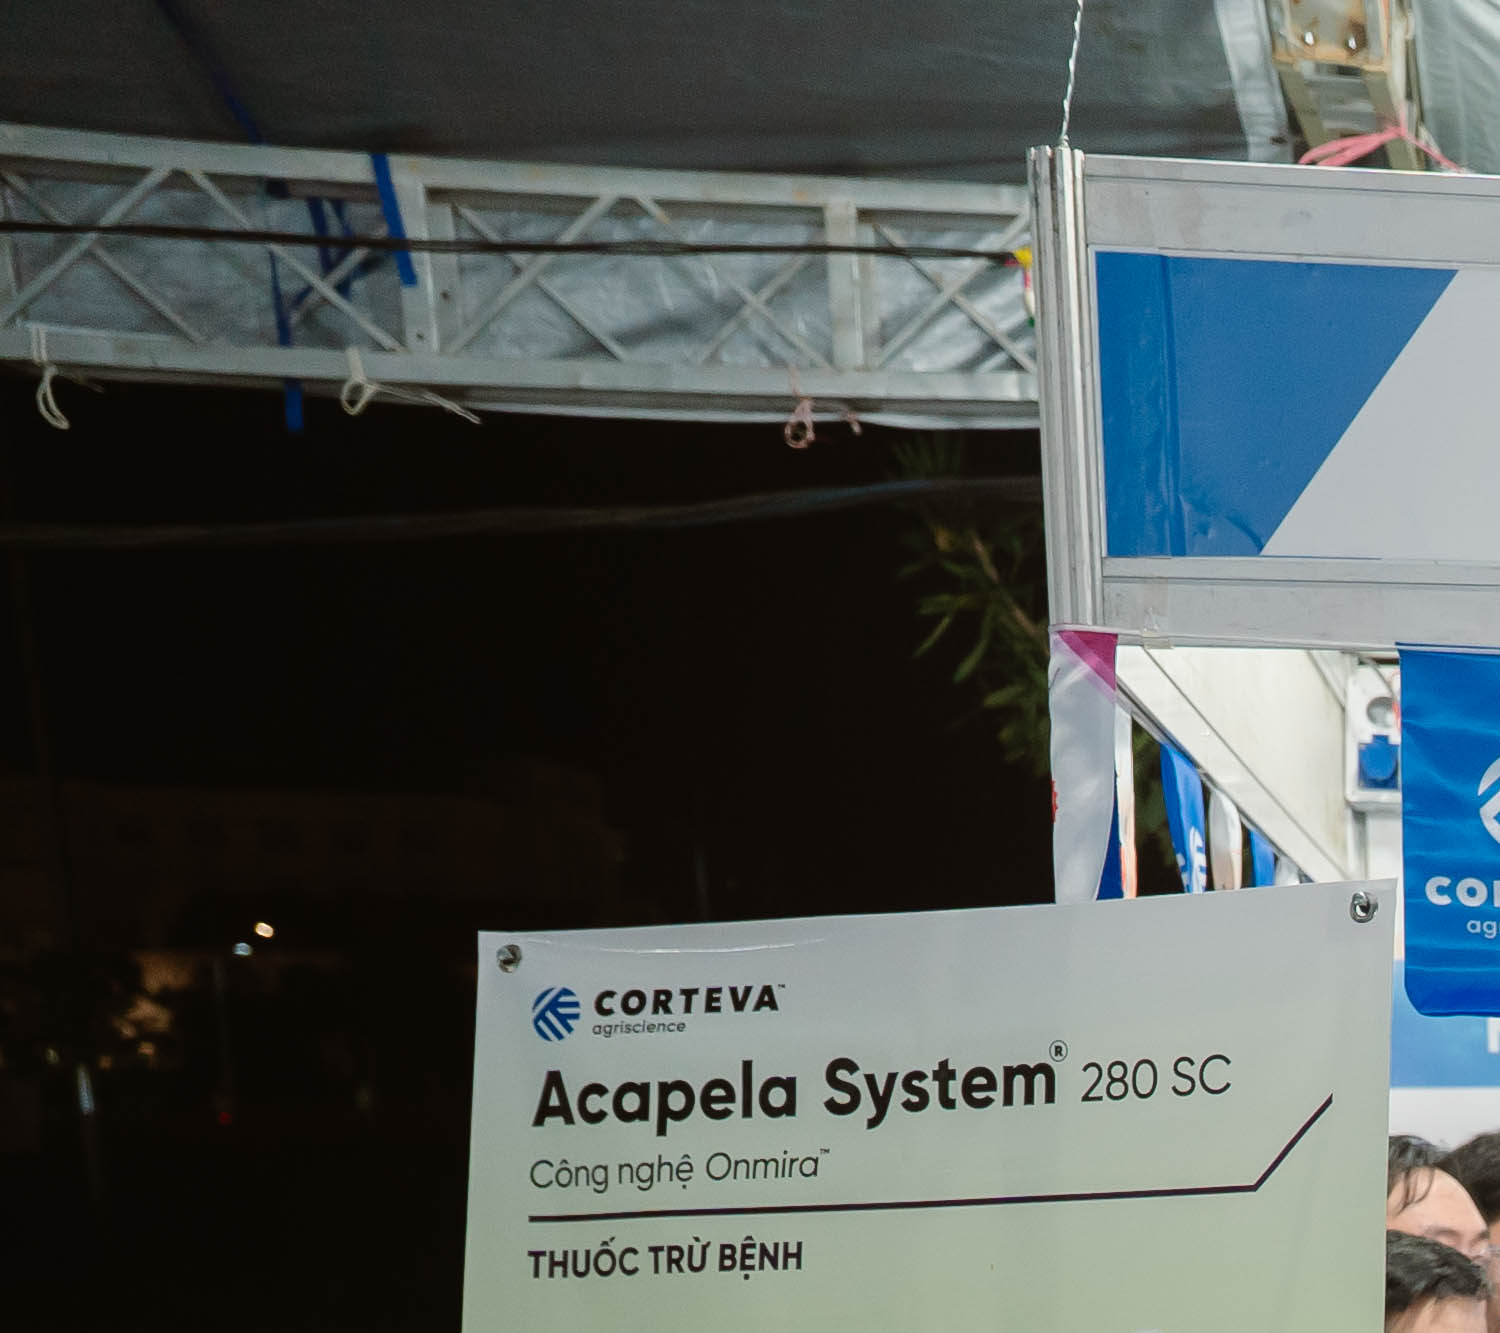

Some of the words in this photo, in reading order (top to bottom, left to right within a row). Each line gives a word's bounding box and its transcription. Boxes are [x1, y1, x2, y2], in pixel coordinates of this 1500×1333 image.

[592, 1018, 686, 1039] agriscience
[533, 1059, 798, 1137] Acapela
[1081, 1058, 1159, 1103] 280
[1171, 1054, 1233, 1098] SC
[530, 1155, 611, 1195] Công
[617, 1150, 696, 1191] nghệ
[527, 1237, 640, 1280] THUỐC
[648, 1237, 715, 1277] TRỪ
[717, 1239, 804, 1282] BỆNH
